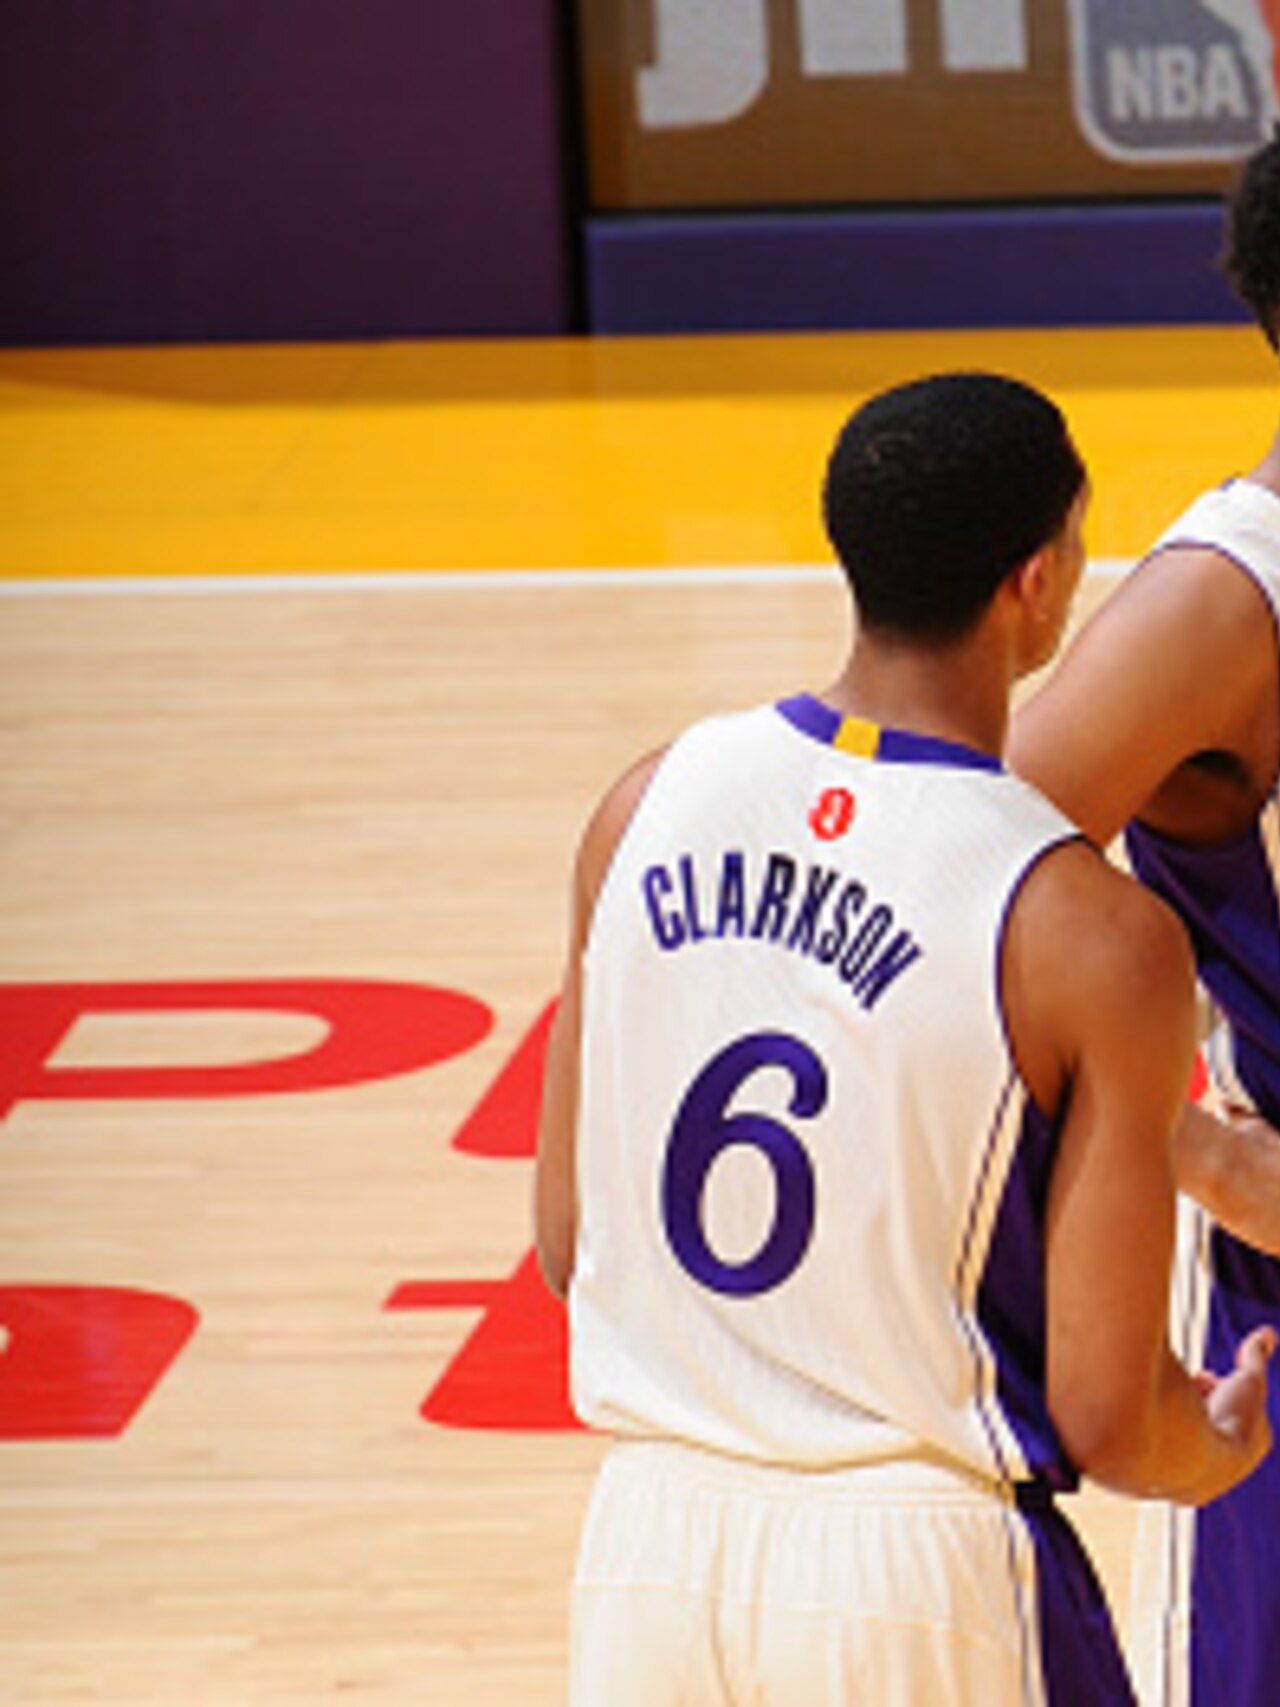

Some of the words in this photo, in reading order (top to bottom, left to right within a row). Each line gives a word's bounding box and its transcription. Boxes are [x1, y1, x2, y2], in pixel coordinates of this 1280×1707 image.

[1106, 44, 1250, 122] NBA
[640, 851, 924, 1012] CLARKSON
[661, 1029, 829, 1299] 6
